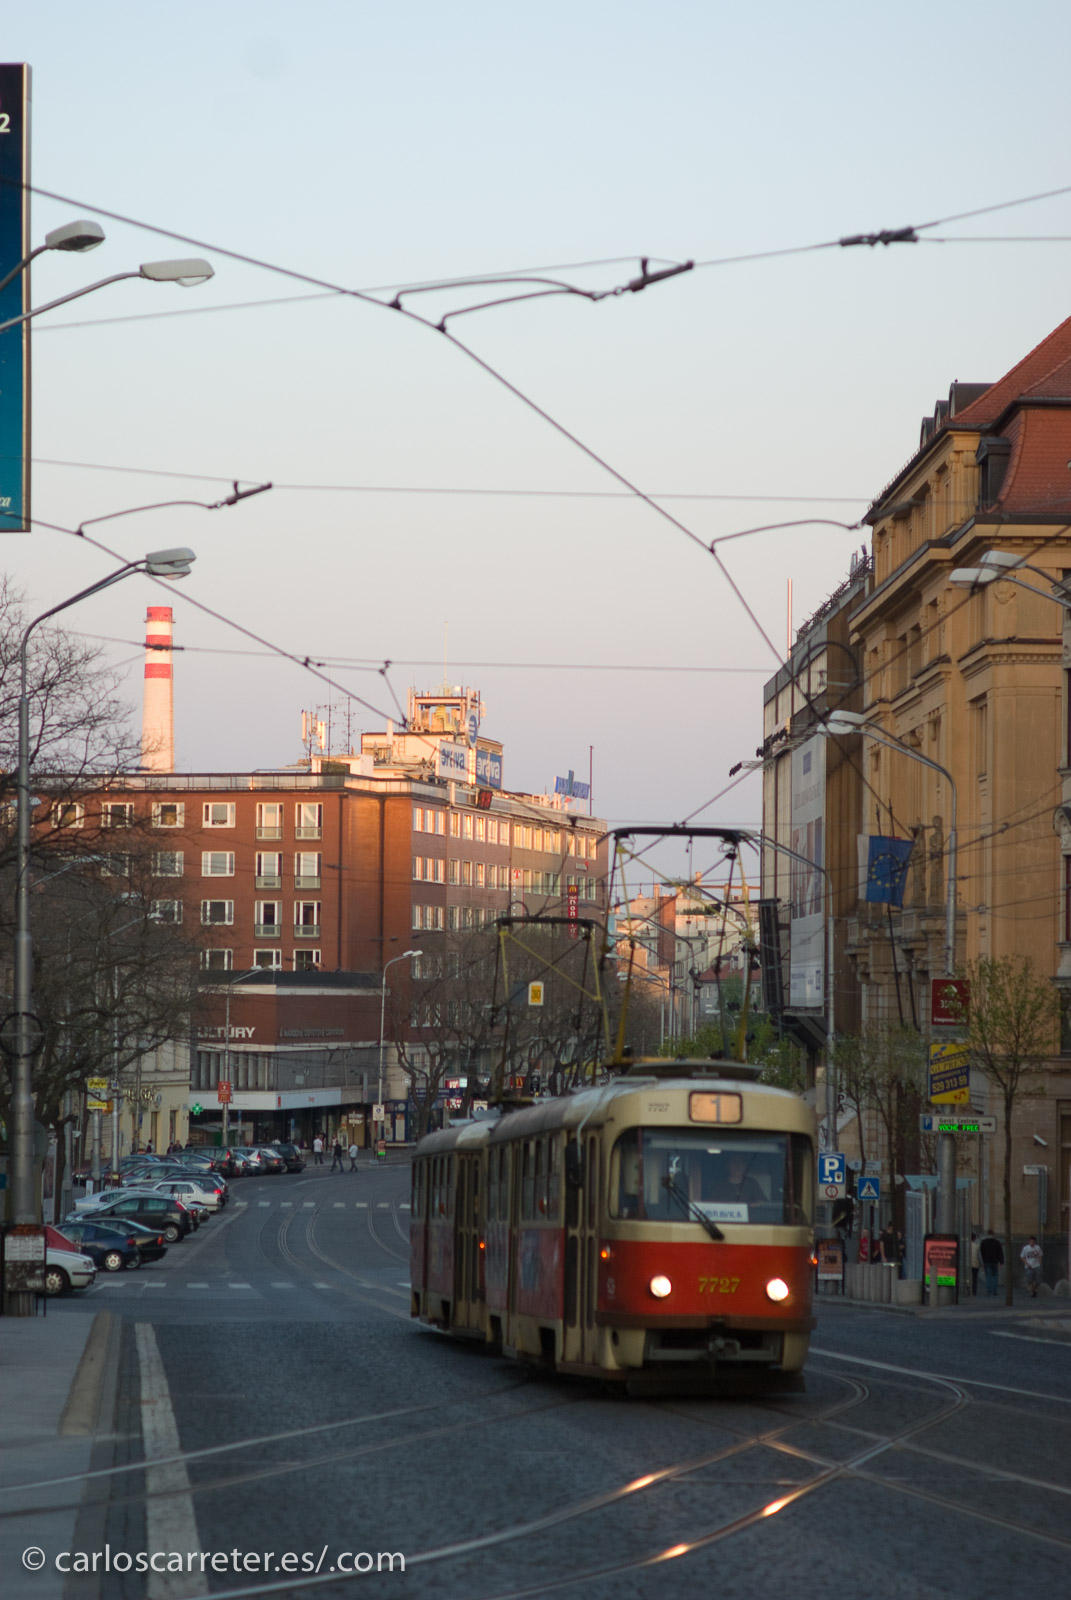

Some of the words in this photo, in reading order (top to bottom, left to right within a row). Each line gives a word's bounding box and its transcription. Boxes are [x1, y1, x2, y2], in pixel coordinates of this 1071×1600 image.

[711, 1096, 721, 1122] 1
[825, 1158, 839, 1177] P
[698, 1276, 742, 1294] 7727
